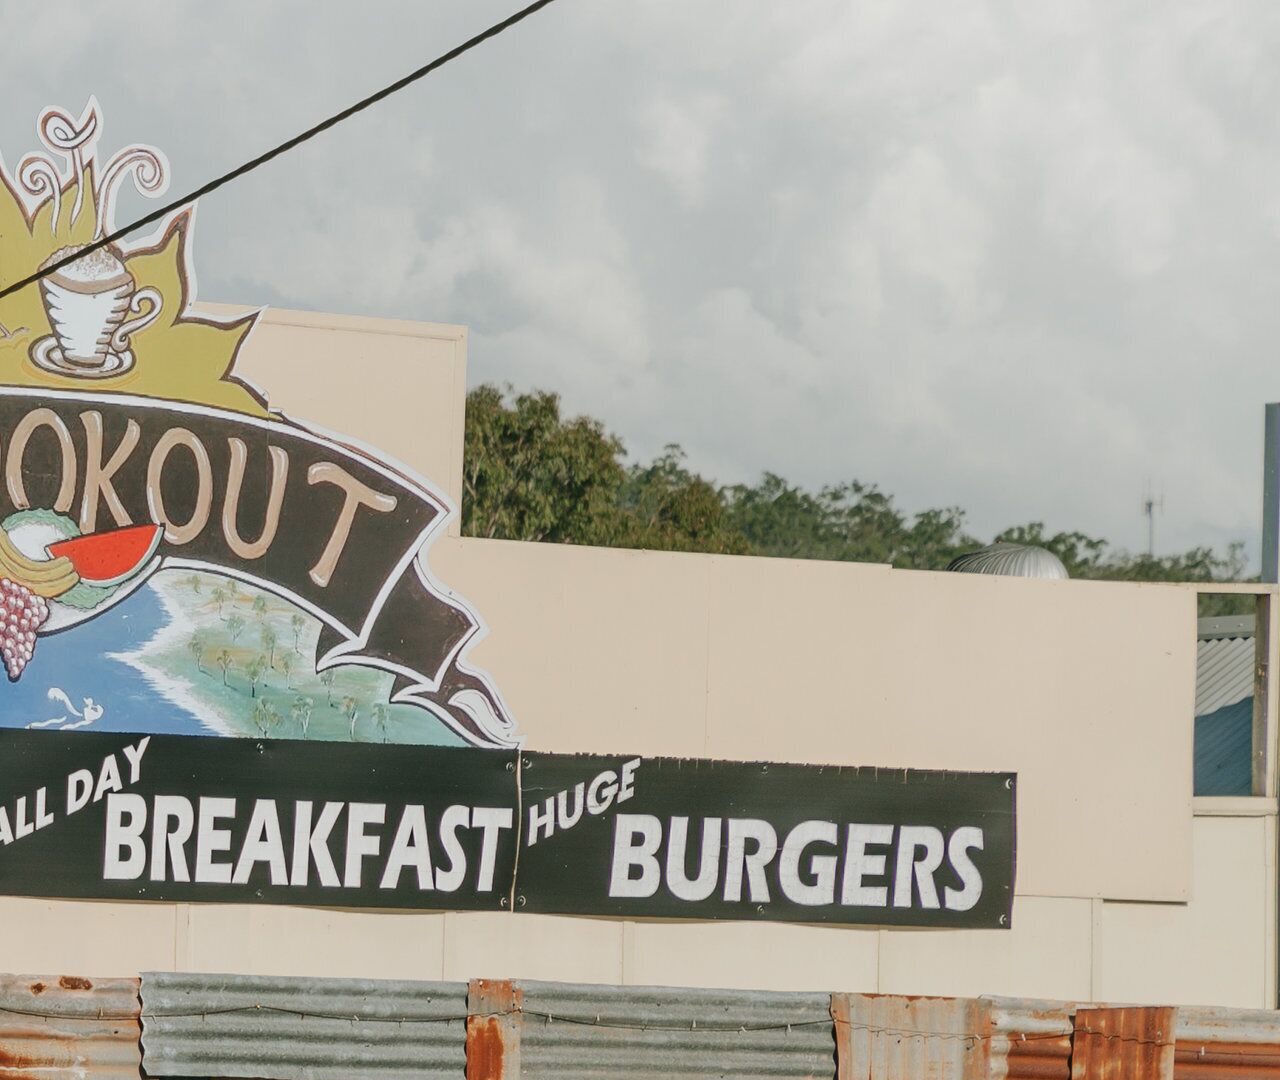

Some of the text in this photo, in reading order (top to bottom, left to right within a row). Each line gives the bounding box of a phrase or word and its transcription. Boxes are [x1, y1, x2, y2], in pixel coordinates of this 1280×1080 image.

[66, 736, 151, 815] DAY
[103, 792, 514, 893] BREAKFAST
[527, 758, 985, 912] HUGE BURGERS
